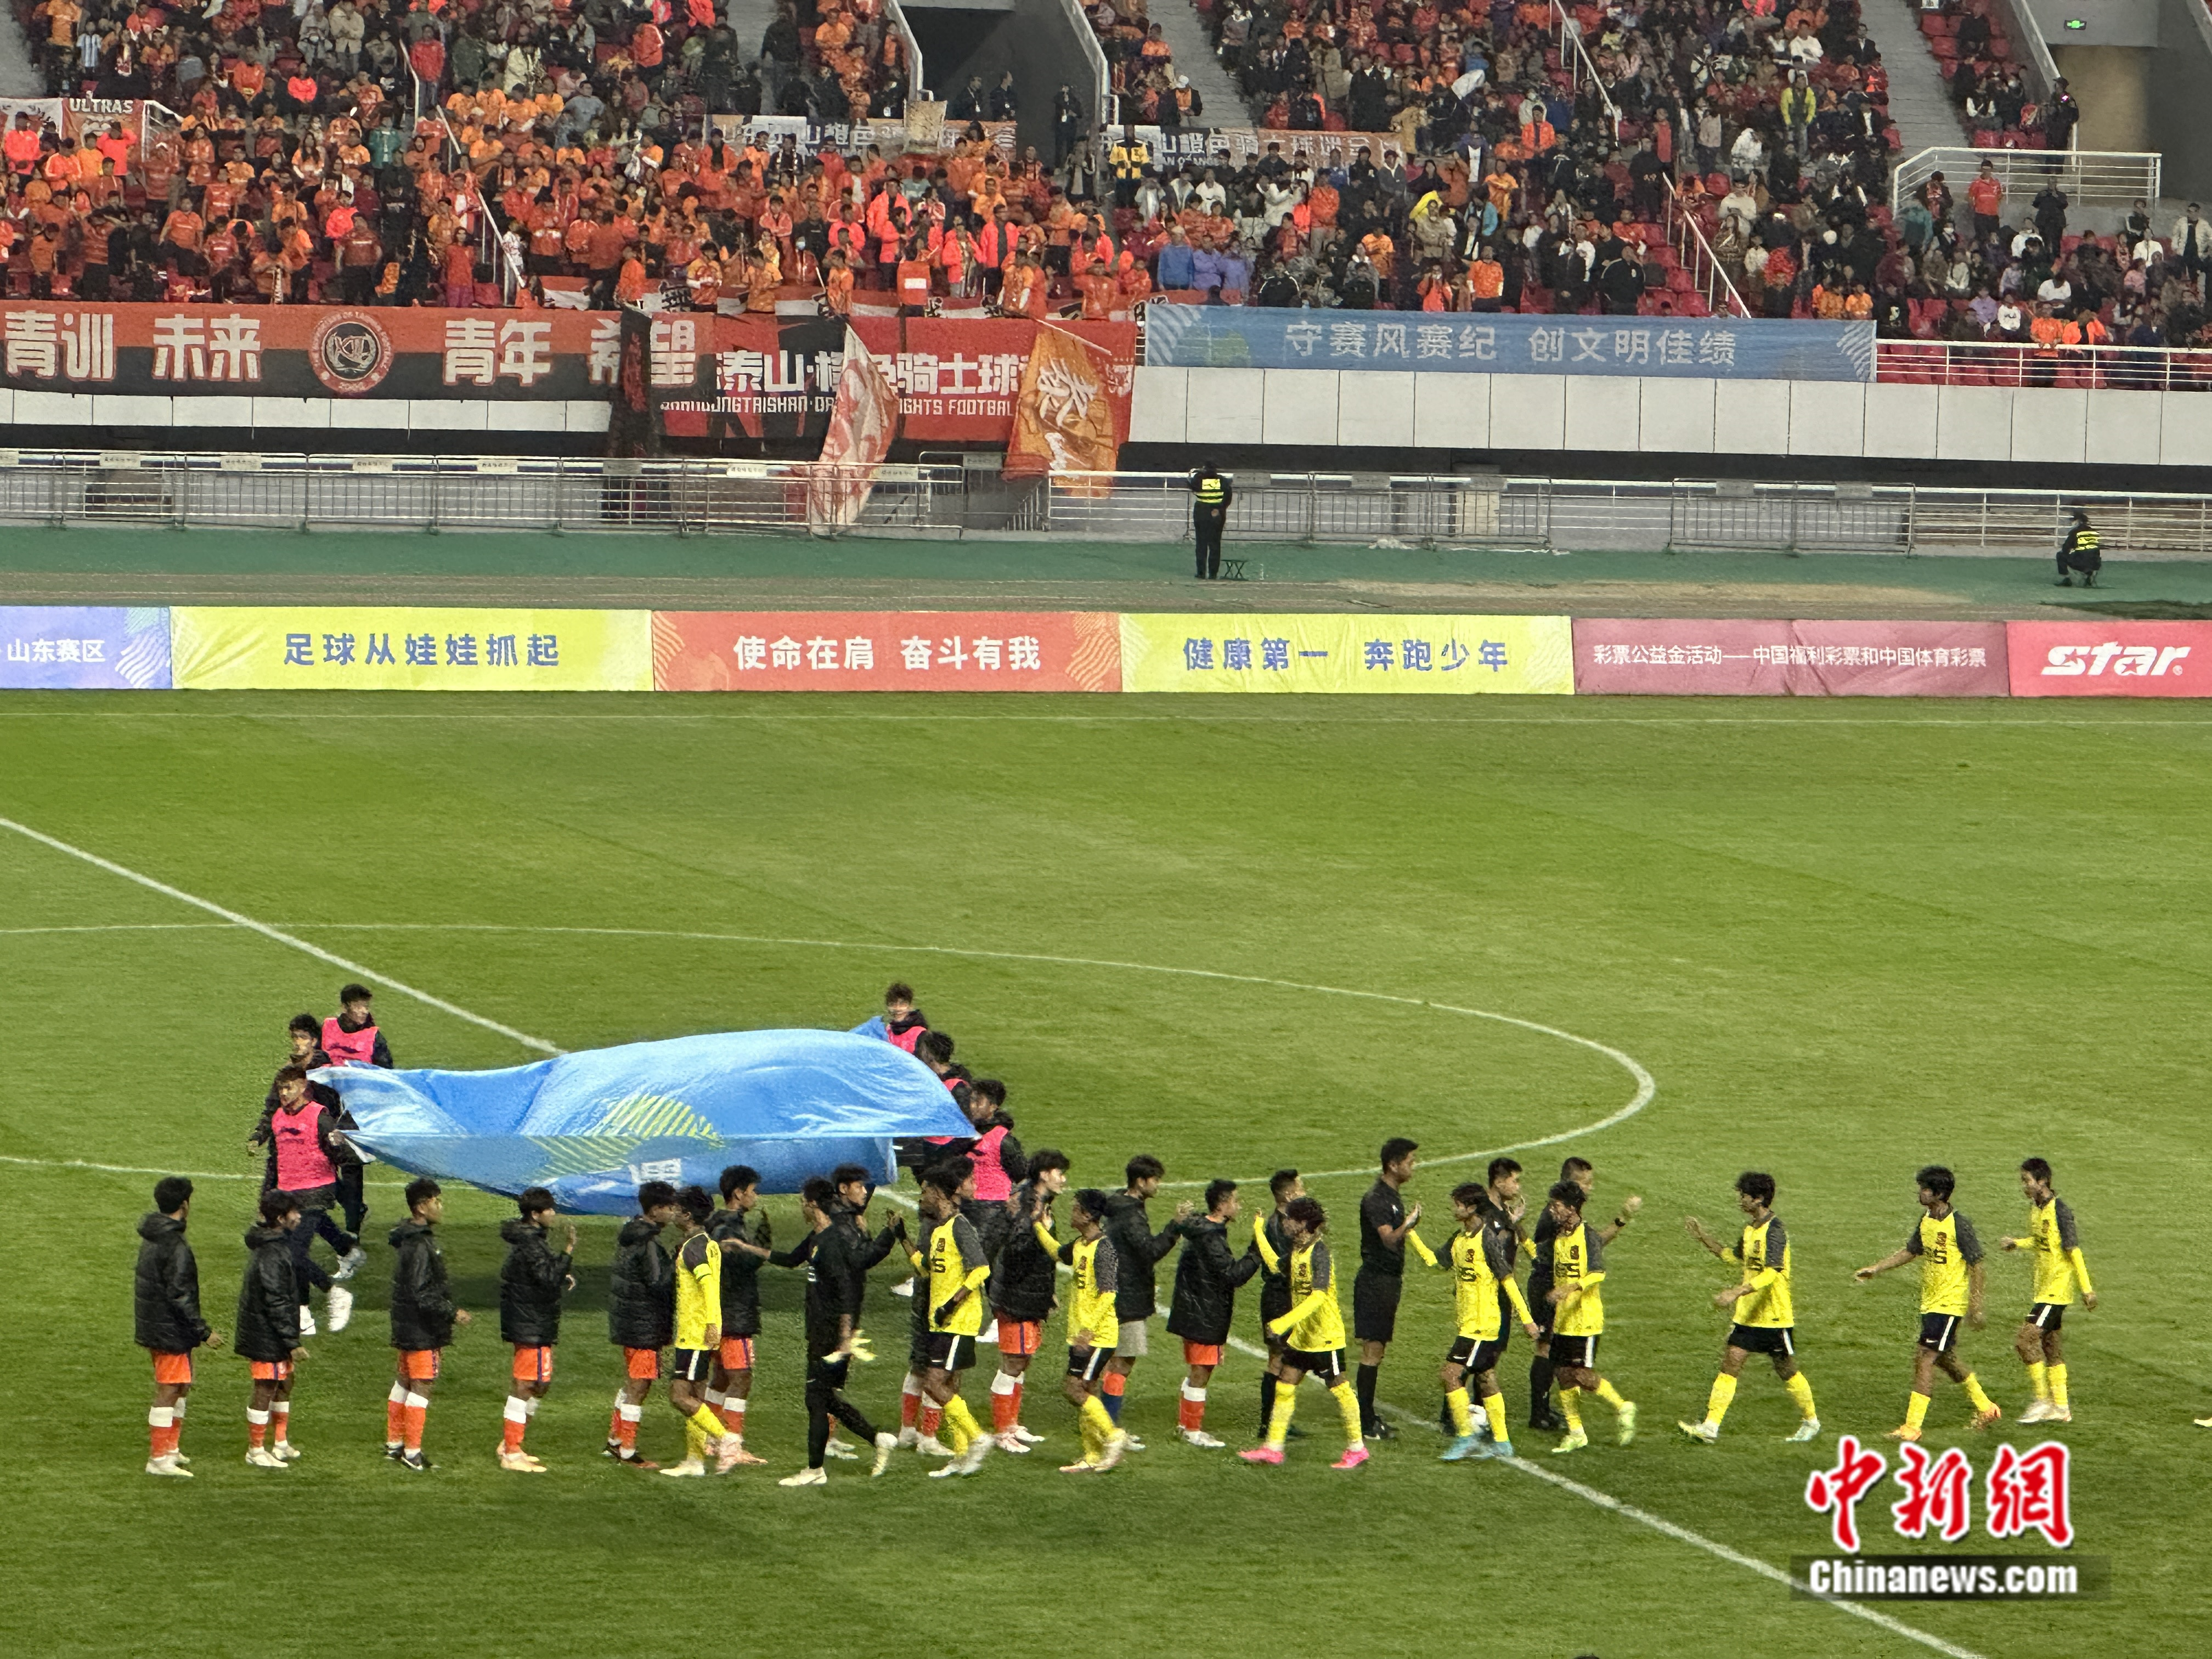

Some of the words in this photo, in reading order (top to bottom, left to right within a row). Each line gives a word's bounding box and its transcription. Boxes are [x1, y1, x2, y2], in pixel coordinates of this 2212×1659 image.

[69, 98, 133, 114] ULTRAS
[4, 310, 114, 379] 青训
[153, 313, 261, 381] 未来
[445, 318, 552, 385] 青年
[1285, 321, 1497, 360] 守赛风赛纪
[1529, 326, 1736, 367] 创文明佳绩
[899, 398, 943, 415] IGHTS
[949, 399, 1014, 416] FOOTBAL
[7, 638, 106, 663] 山东赛区
[284, 633, 560, 667] 足球从娃娃抓起
[733, 635, 874, 670] 使命在肩
[900, 635, 1041, 670] 奋斗有我
[1183, 637, 1329, 672] 健康第一
[1364, 638, 1509, 672] 奔跑少年
